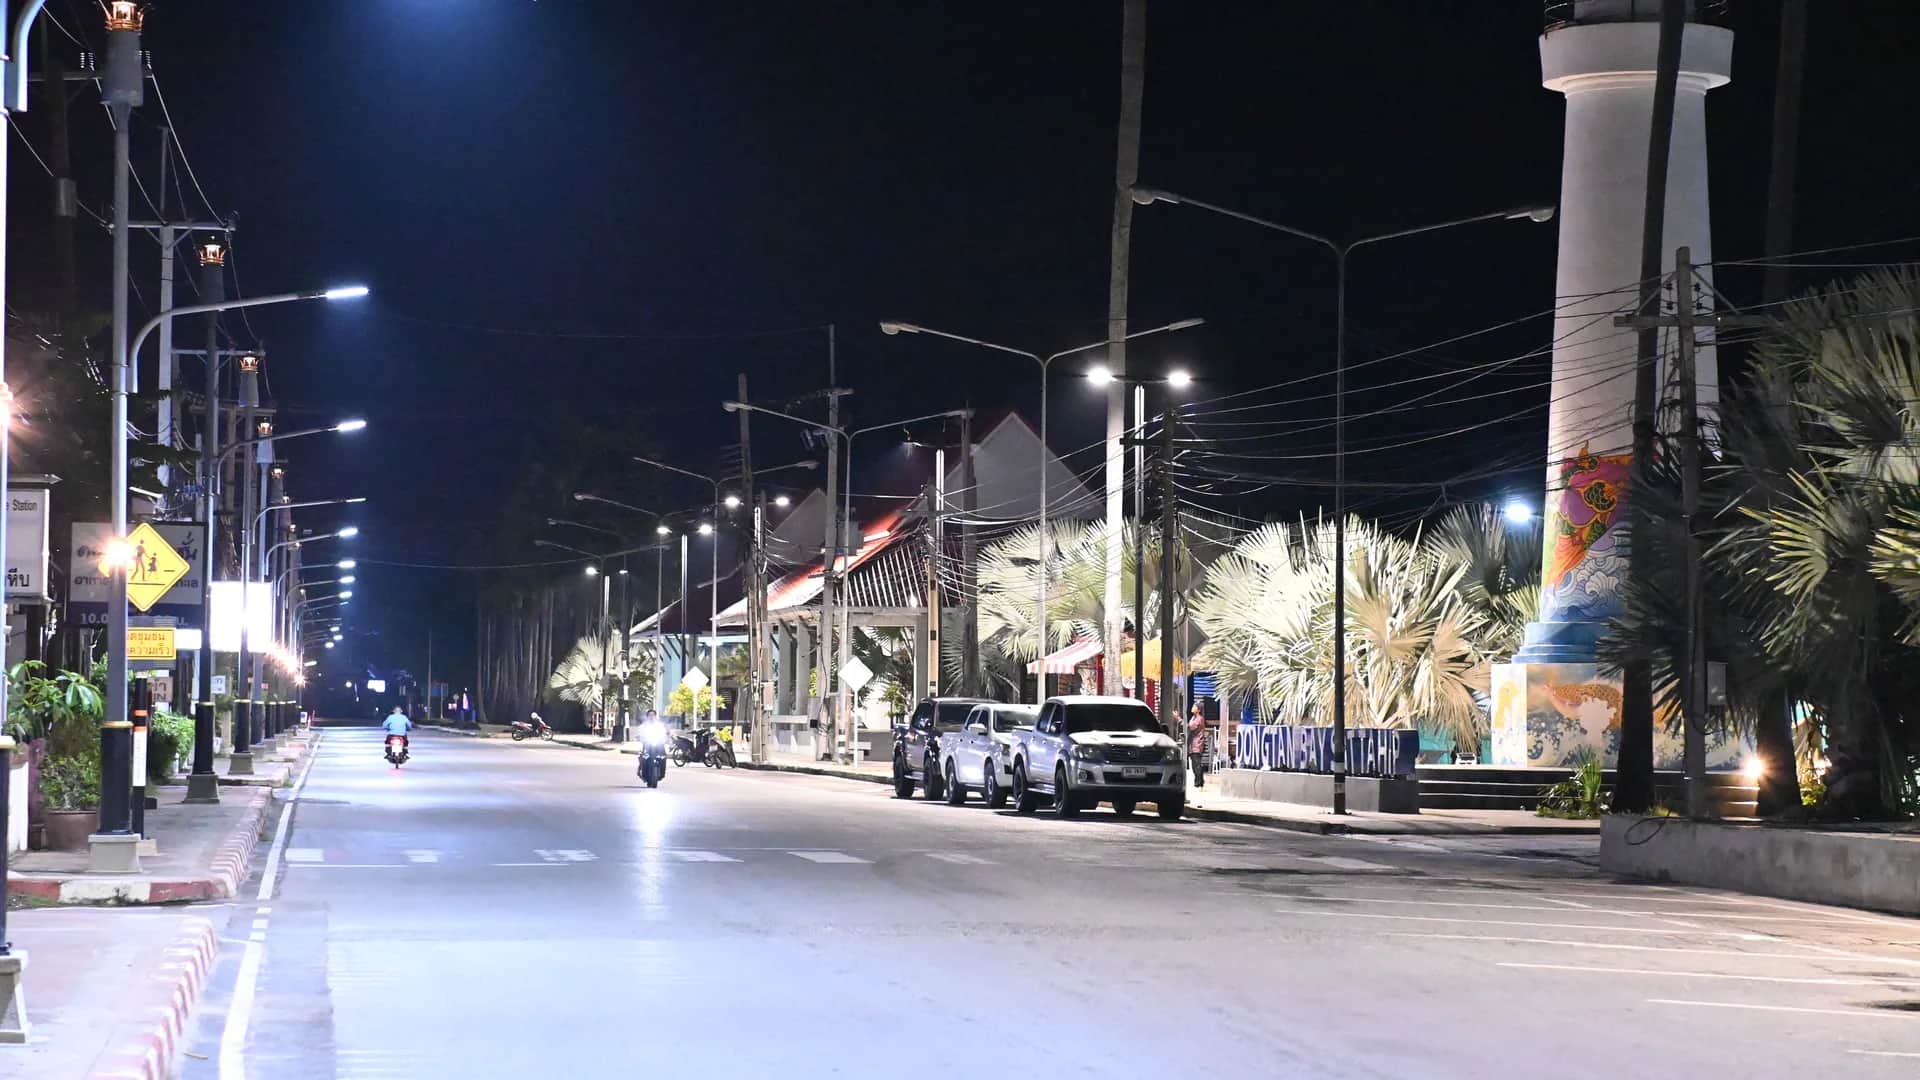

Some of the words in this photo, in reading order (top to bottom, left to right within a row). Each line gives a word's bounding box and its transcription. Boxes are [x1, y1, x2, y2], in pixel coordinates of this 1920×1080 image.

[12, 499, 38, 511] Station
[79, 613, 109, 624] 10.0
[1235, 726, 1295, 769] DONGTAN
[1300, 728, 1326, 771] BAY
